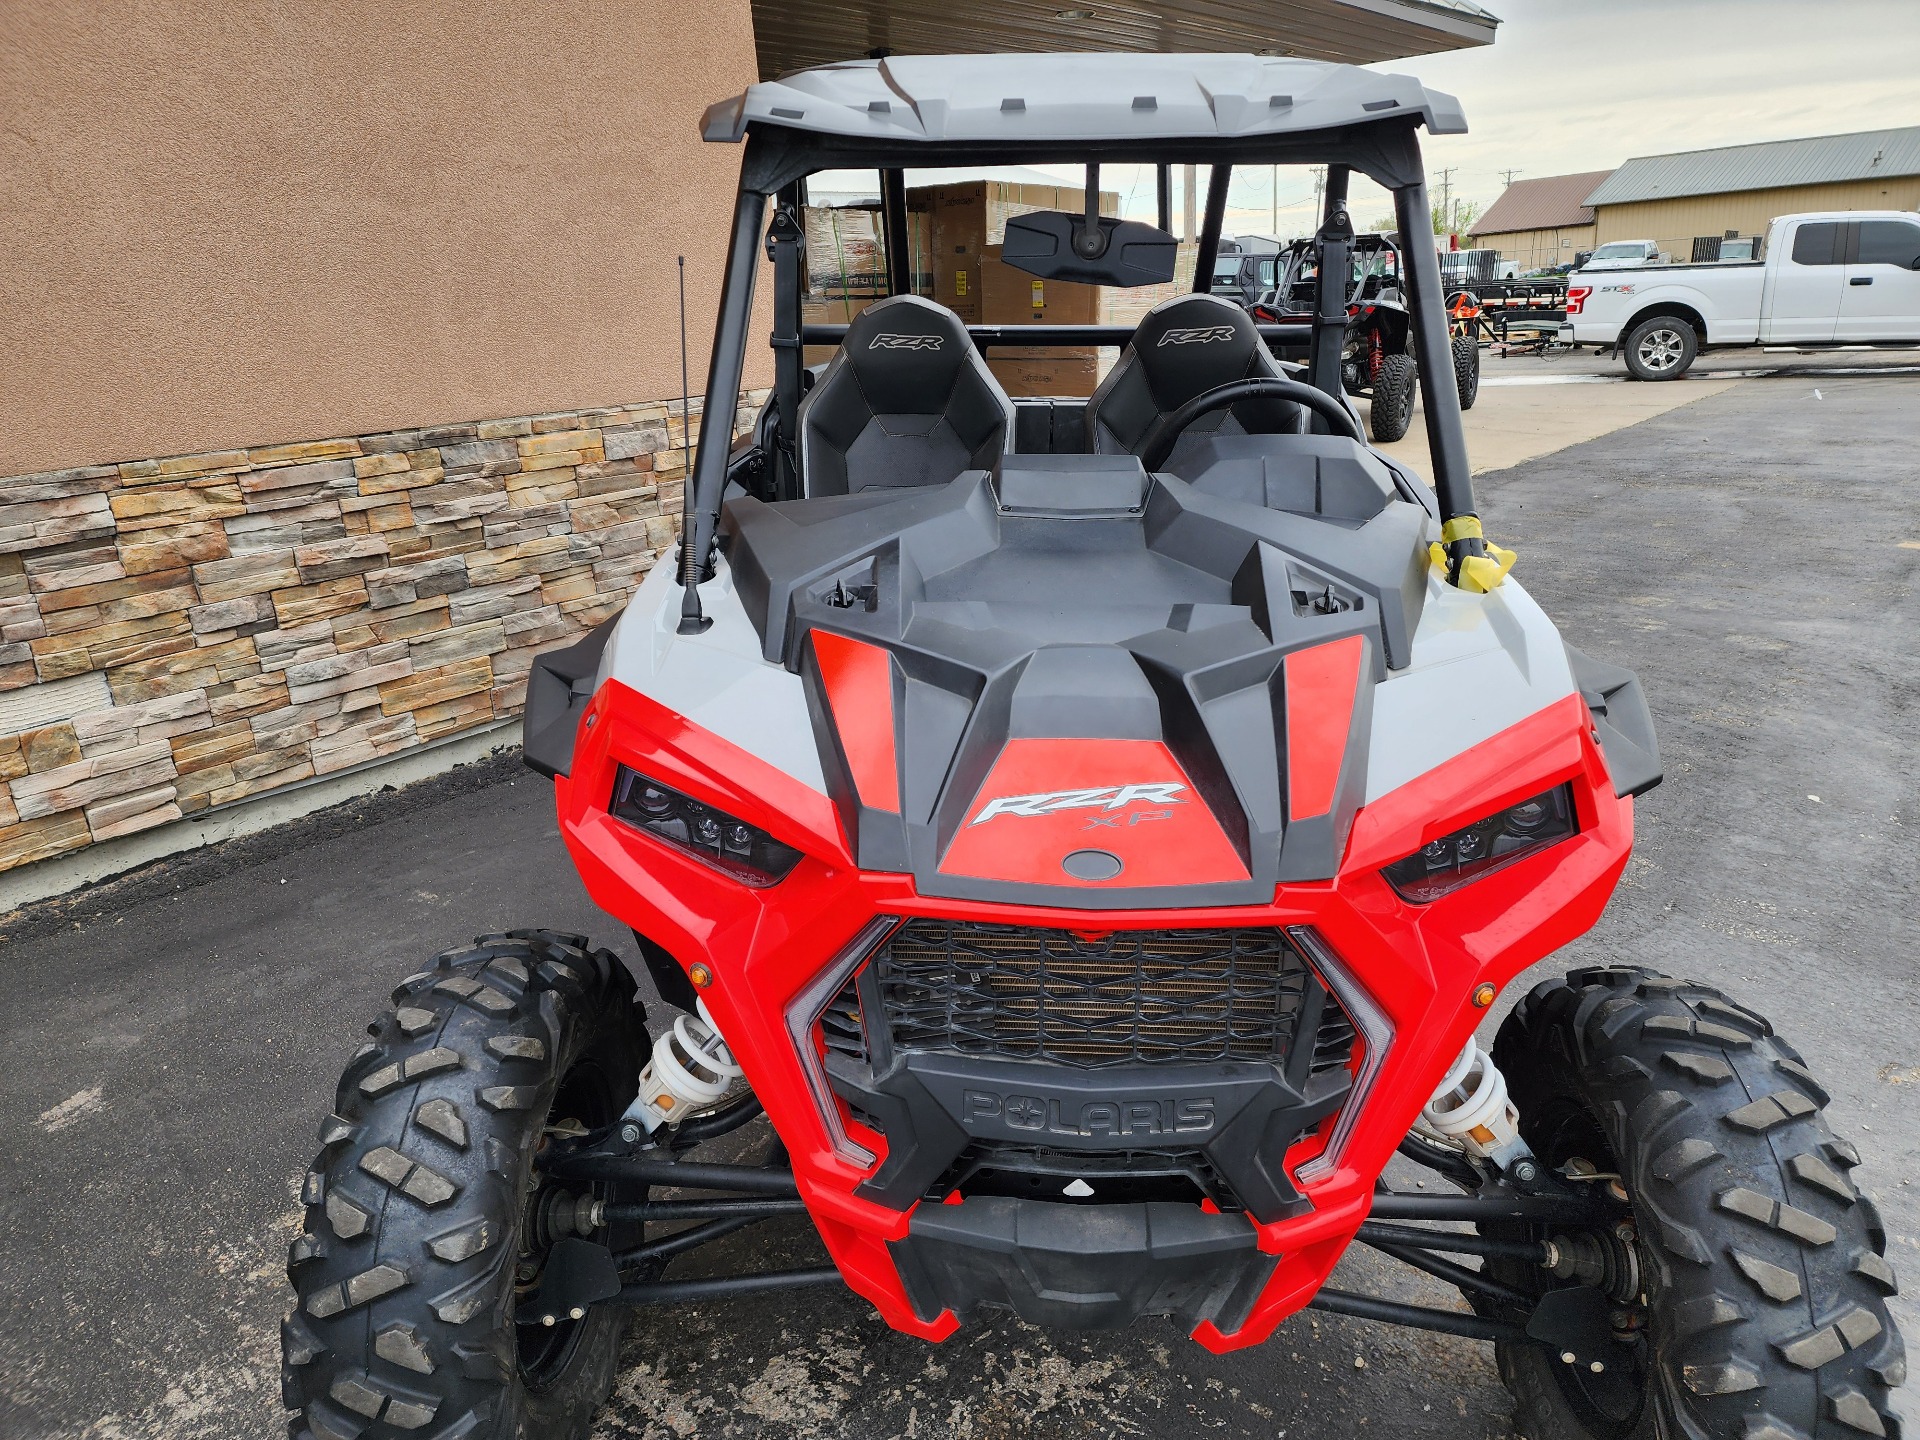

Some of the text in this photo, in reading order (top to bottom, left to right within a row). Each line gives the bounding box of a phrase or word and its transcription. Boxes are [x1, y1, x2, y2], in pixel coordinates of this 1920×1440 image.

[868, 333, 945, 350] RZR
[1157, 325, 1236, 347] RZR
[963, 781, 1190, 829] RZR
[1081, 810, 1174, 831] XP
[963, 1089, 1216, 1136] POLARIS
